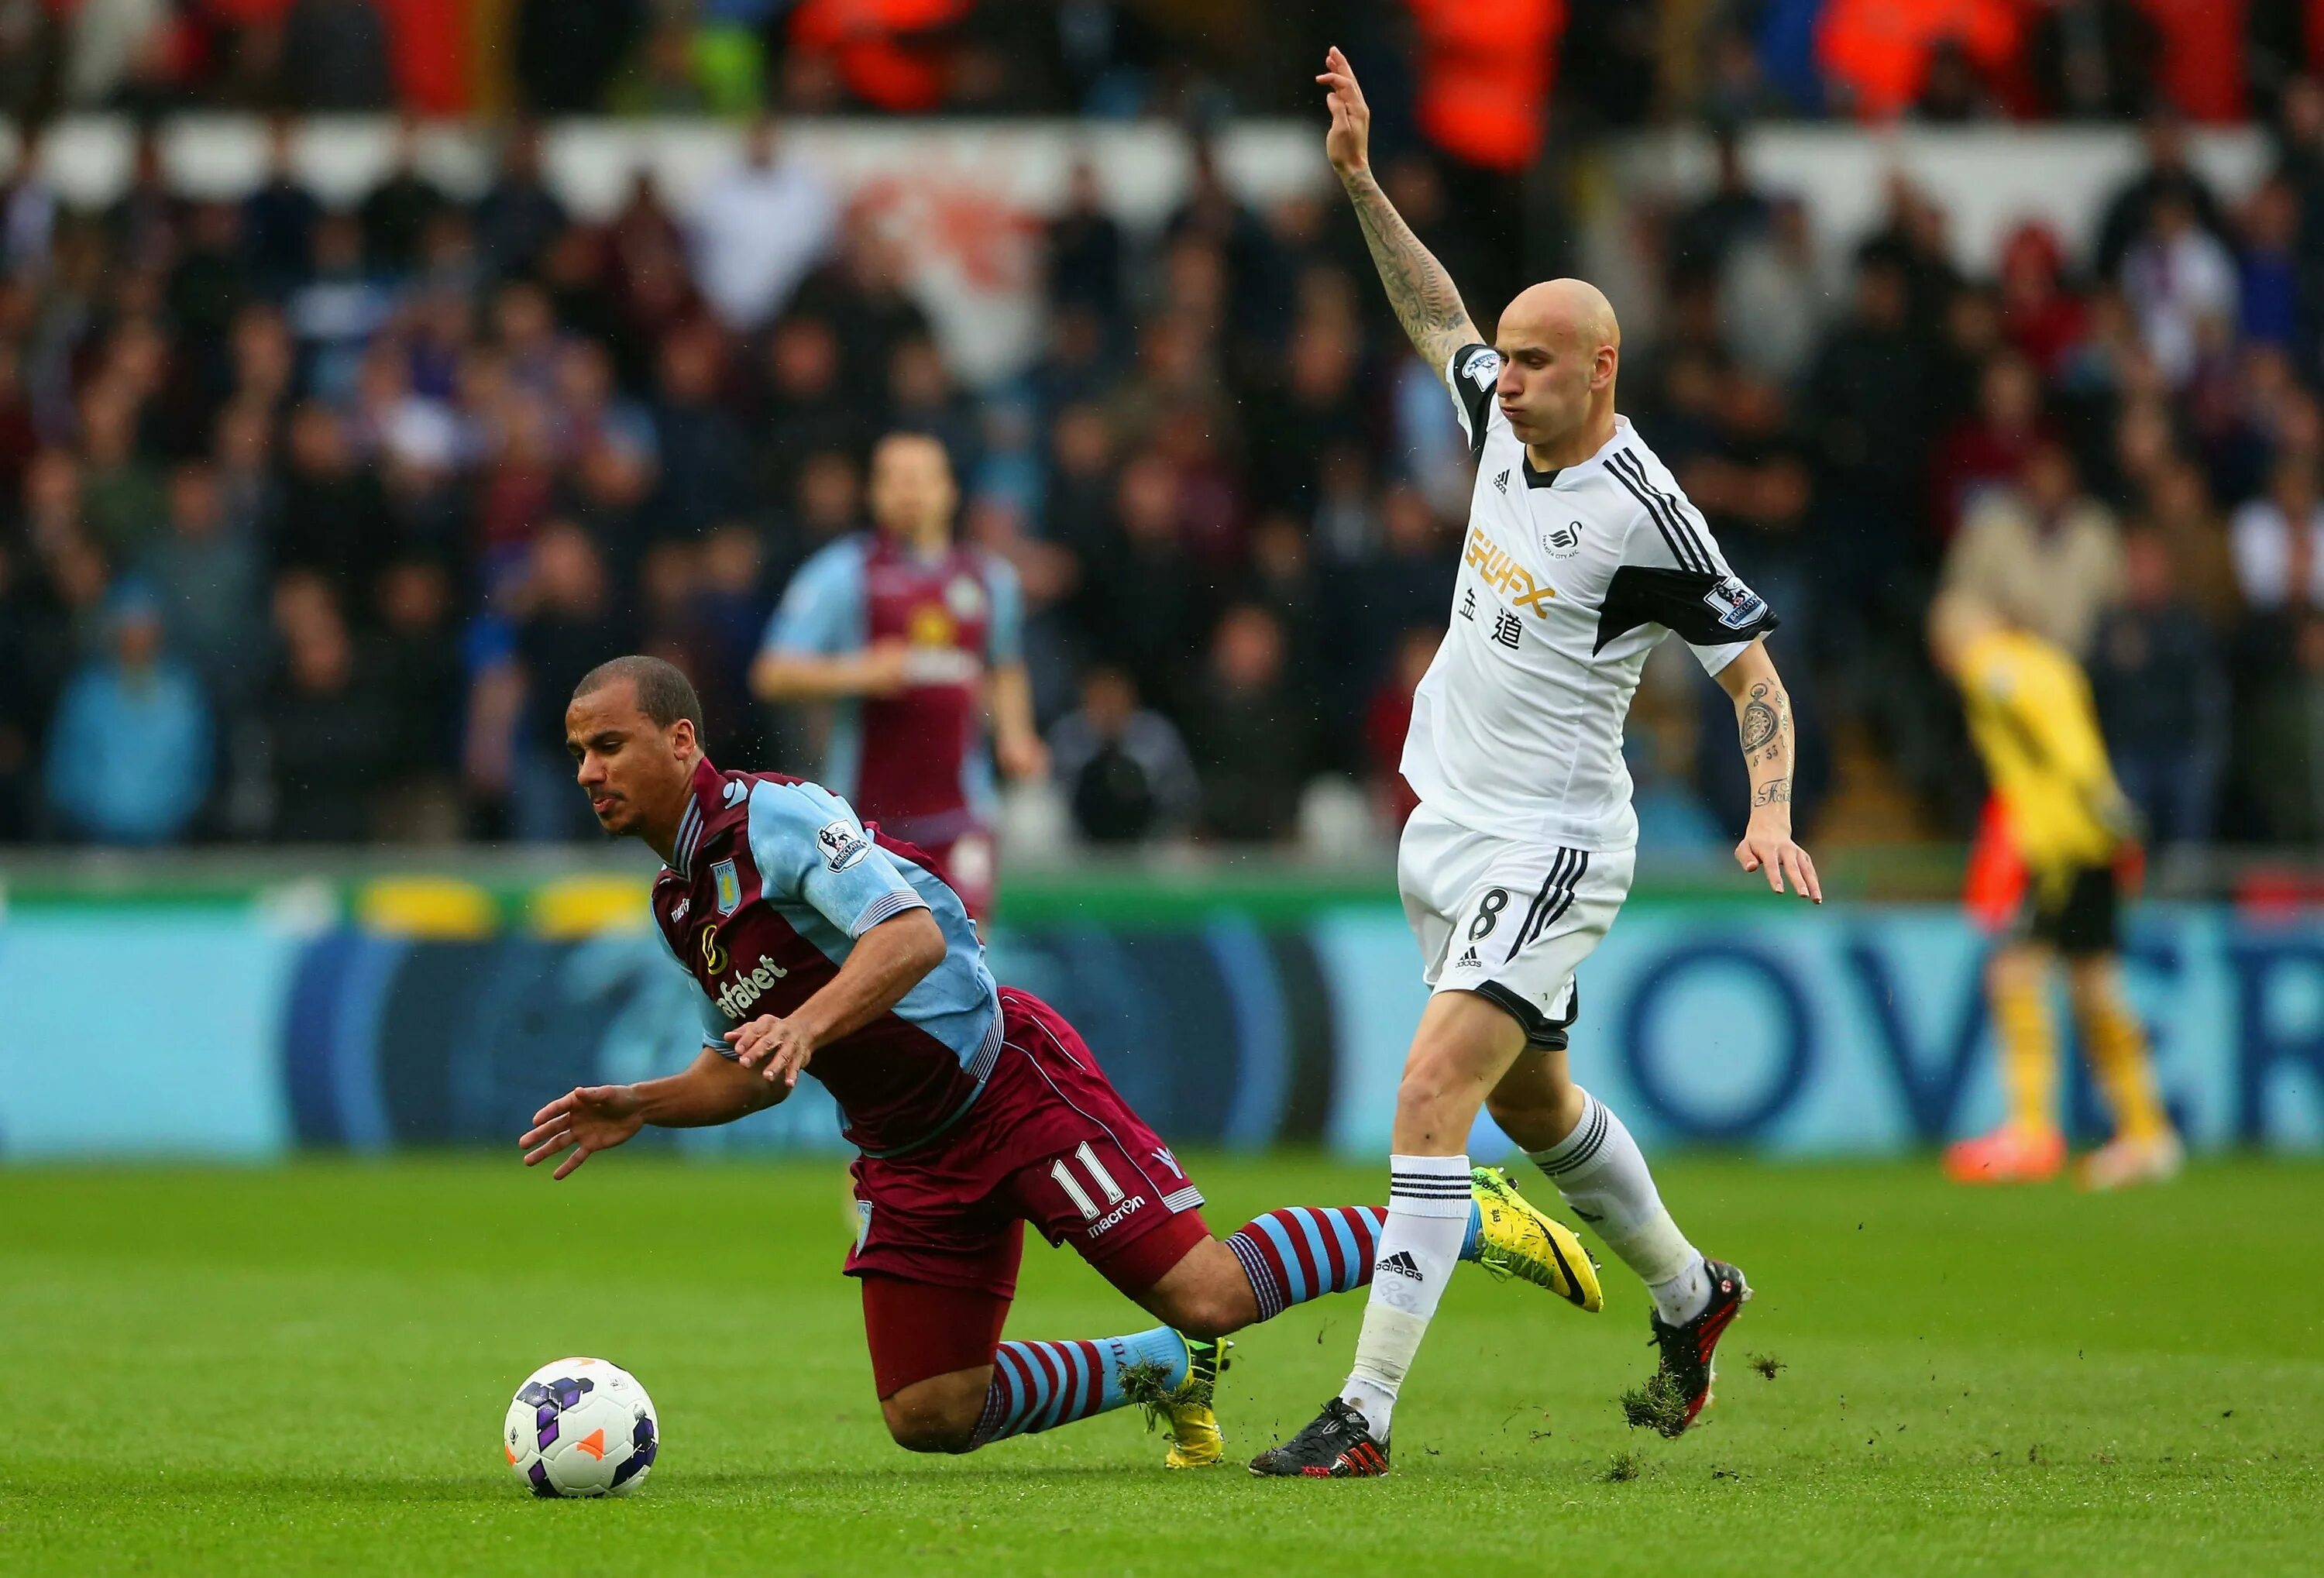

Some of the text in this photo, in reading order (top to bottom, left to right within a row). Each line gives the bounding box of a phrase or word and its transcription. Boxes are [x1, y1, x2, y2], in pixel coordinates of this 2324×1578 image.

[1729, 595, 1758, 621] BARCLAYS
[1469, 889, 1508, 941] 8
[1051, 1141, 1125, 1222] 11
[1087, 1195, 1145, 1238] macron
[1376, 1263, 1424, 1281] adidas
